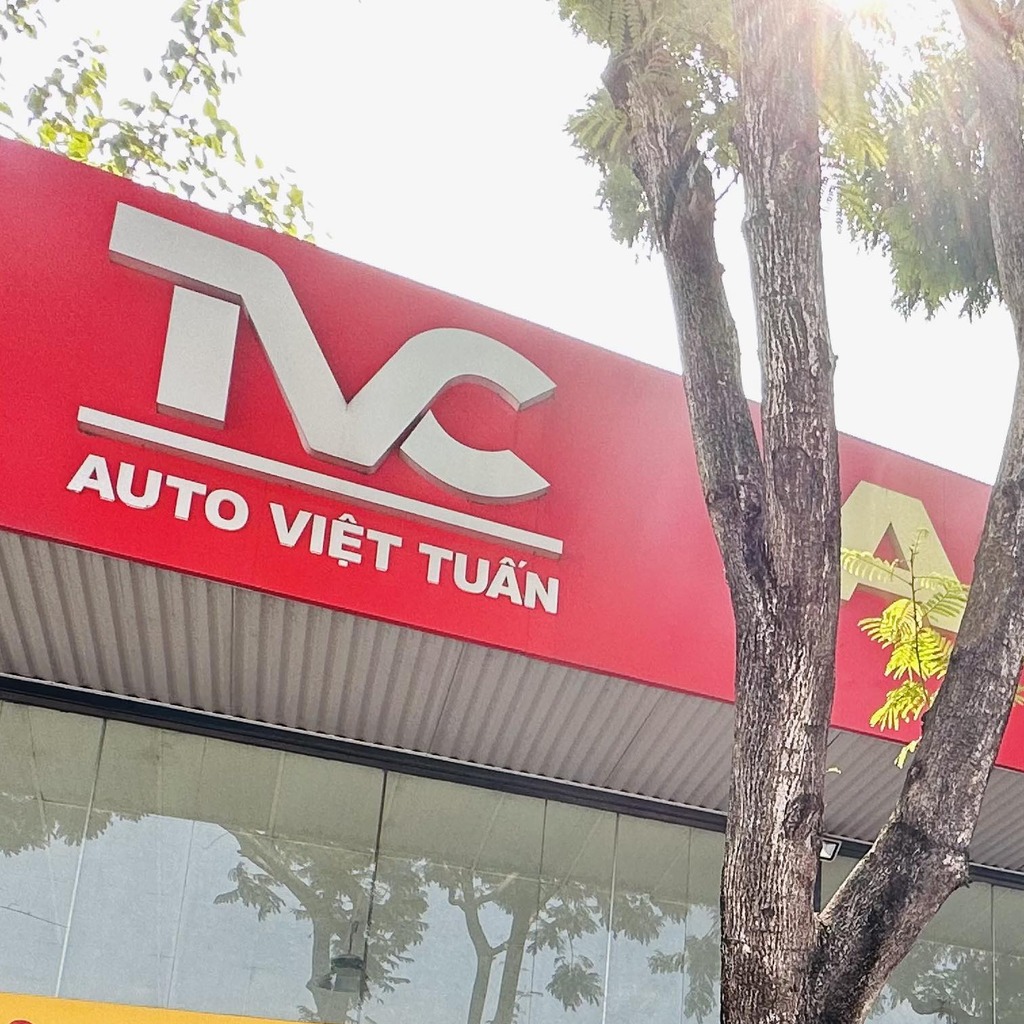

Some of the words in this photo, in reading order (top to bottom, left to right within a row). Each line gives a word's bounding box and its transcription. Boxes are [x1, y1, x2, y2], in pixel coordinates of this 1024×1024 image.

[66, 454, 250, 532] AUTO
[268, 502, 403, 572] VIỆT
[418, 543, 560, 615] TUẤN
